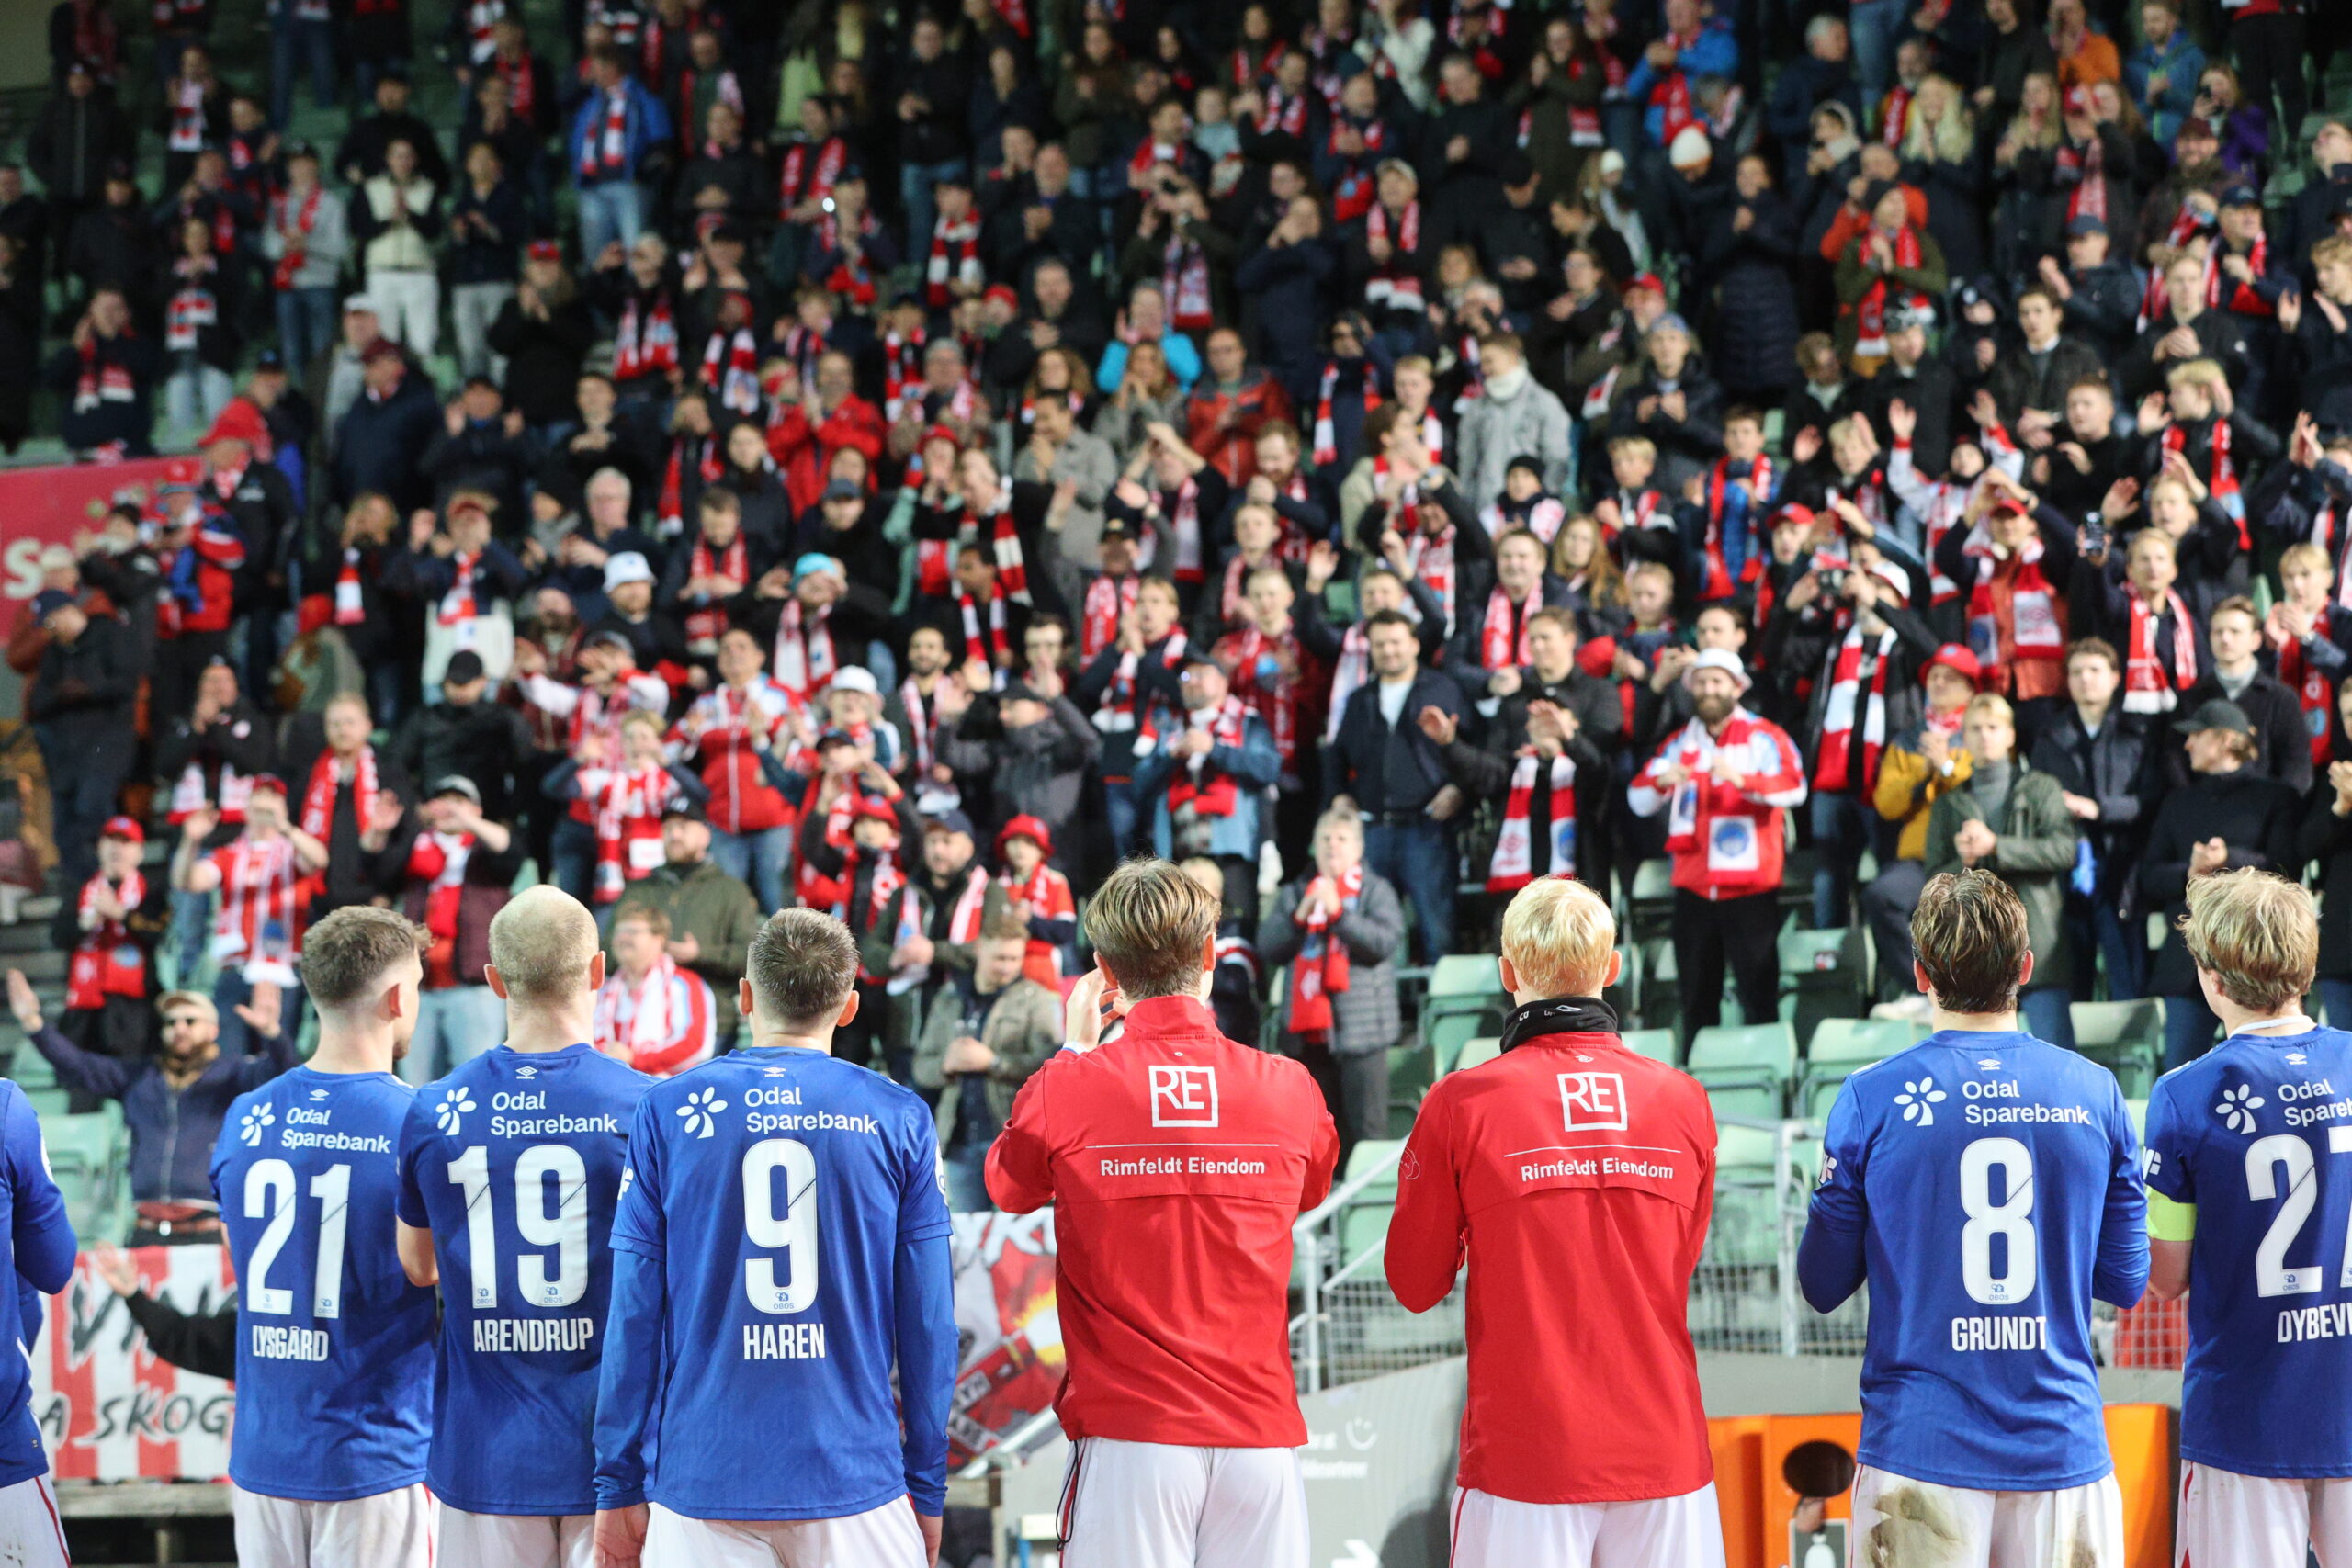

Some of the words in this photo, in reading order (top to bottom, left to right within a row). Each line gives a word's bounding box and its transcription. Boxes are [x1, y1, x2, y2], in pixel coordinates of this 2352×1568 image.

[492, 1090, 547, 1111] Odal
[744, 1086, 803, 1108] Odal
[1148, 1066, 1205, 1110] RE
[1557, 1072, 1615, 1113] RE
[1962, 1080, 2020, 1100] Odal
[2278, 1078, 2335, 1102] Odal
[285, 1107, 331, 1126] Odal
[491, 1113, 618, 1139] Sparebank
[746, 1111, 878, 1134] Sparebank
[1965, 1104, 2091, 1127] Sparebank
[281, 1129, 391, 1155] Sparebank
[1100, 1156, 1182, 1176] Rimfeldt
[1188, 1156, 1265, 1174] Eiendom
[1521, 1158, 1598, 1182] Rimfeldt
[1603, 1157, 1674, 1179] Eiendom
[447, 1145, 588, 1309] 19
[741, 1138, 819, 1314] 9
[1960, 1137, 2036, 1305] 8
[243, 1158, 352, 1319] 21
[252, 1325, 329, 1362] LYSGÅRD
[473, 1317, 594, 1353] ARENDRUP
[742, 1324, 825, 1360] HAREN
[1951, 1316, 2047, 1352] GRUNDT
